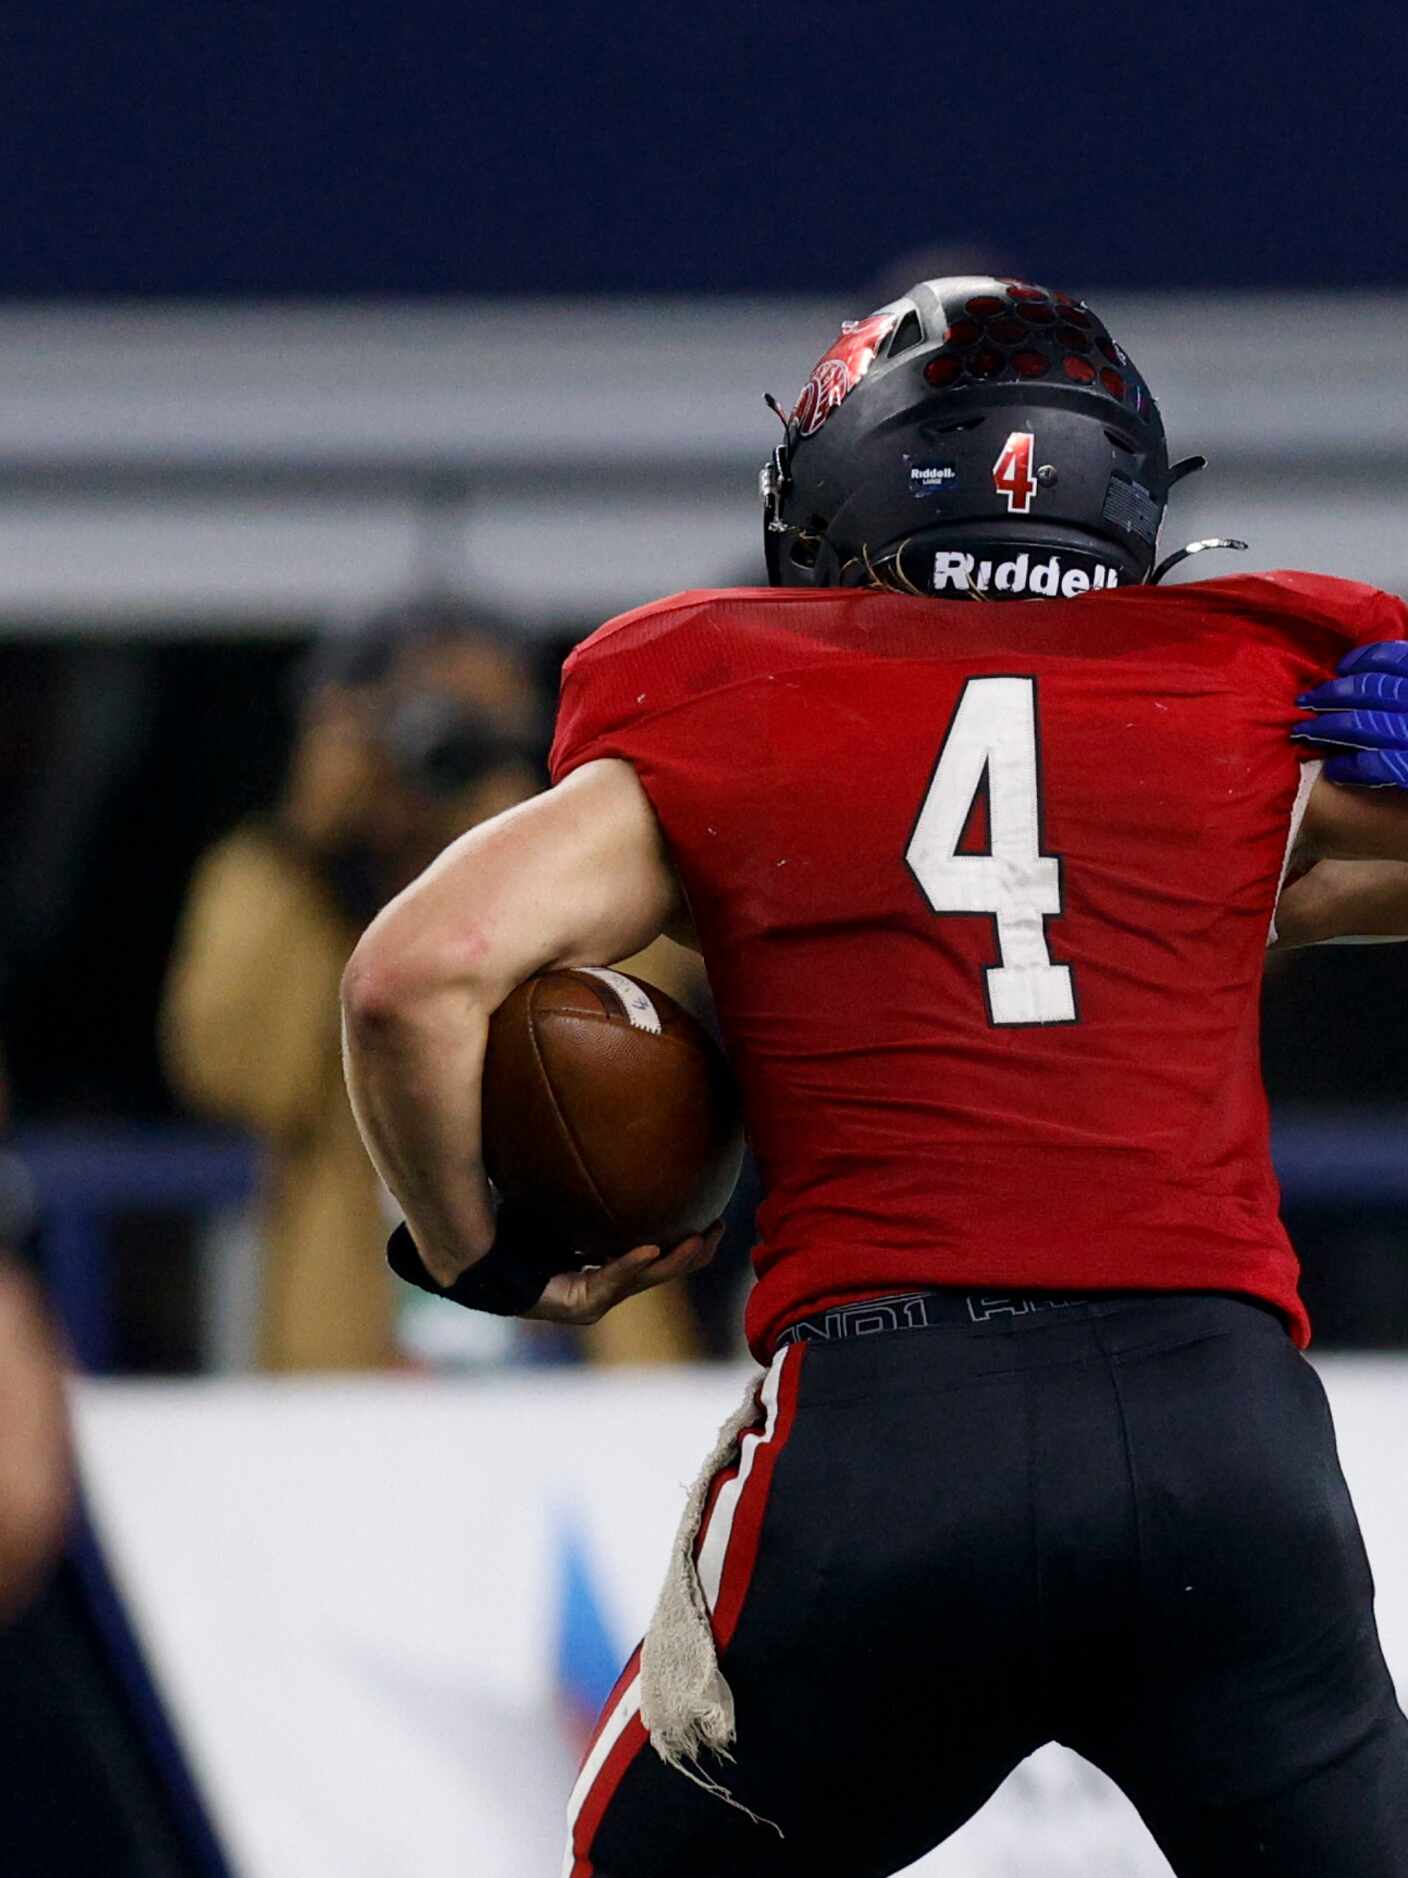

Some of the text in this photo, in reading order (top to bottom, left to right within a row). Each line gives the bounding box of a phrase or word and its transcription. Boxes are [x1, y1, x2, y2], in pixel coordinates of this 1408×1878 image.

[992, 432, 1037, 513] 4
[933, 551, 1119, 598] Riddell
[904, 675, 1079, 1027] 4
